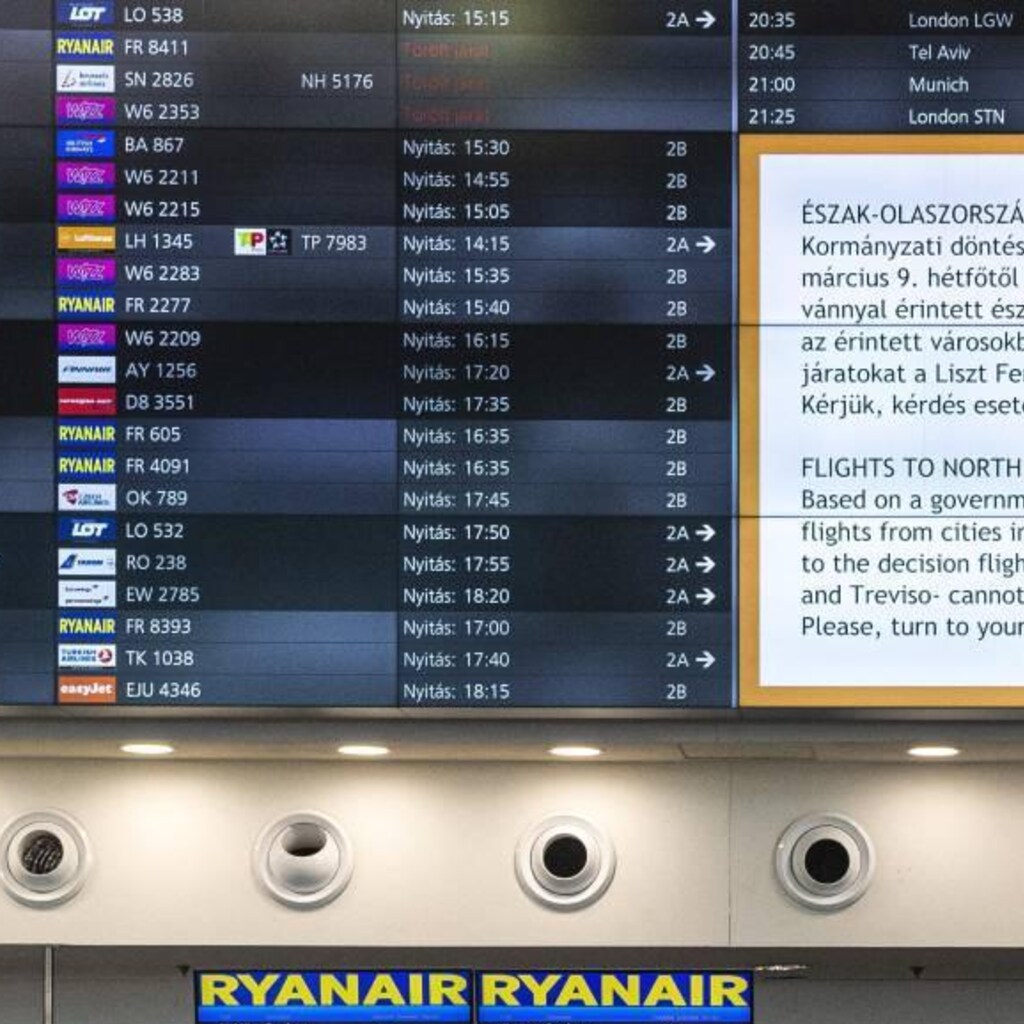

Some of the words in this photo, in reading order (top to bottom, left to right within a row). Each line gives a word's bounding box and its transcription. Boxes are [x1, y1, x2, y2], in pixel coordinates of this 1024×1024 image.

[748, 11, 796, 28] 20:35
[909, 11, 969, 28] London
[974, 11, 1014, 28] LGW
[748, 44, 796, 60] 20:45
[908, 43, 932, 61] Tel
[936, 44, 971, 61] Aviv
[124, 70, 147, 88] SN
[151, 71, 194, 88] 2826
[301, 73, 326, 89] NH
[332, 73, 374, 90] 5176
[748, 107, 796, 125] 21:25
[908, 108, 969, 125] London
[974, 108, 1005, 125] STN
[125, 233, 147, 249] LH
[152, 233, 193, 250] 1345
[300, 234, 322, 250] TP
[325, 234, 367, 251] 7983
[403, 234, 456, 255] Nyitás:
[465, 235, 510, 252] 14:15
[666, 236, 690, 253] 2A
[802, 234, 942, 261] Kormányzati
[57, 296, 116, 313] RYANAIR
[125, 296, 145, 313] FR
[149, 297, 191, 313] 2277
[403, 298, 456, 319] Nyitás:
[465, 299, 510, 316] 15:40
[666, 300, 688, 317] 2B
[801, 336, 827, 352] az
[834, 329, 923, 352] érintett
[125, 394, 150, 411] D8
[154, 394, 193, 411] 3551
[403, 396, 456, 416] Nyitás:
[465, 396, 510, 413] 17:35
[666, 396, 688, 413] 2B
[802, 393, 882, 420] Kérjük,
[892, 393, 966, 415] kérdés
[802, 457, 895, 478] FLIGHTS
[902, 457, 935, 478] TO
[943, 457, 1021, 478] NORTH
[802, 488, 866, 510] Based
[873, 493, 901, 510] on
[909, 494, 922, 510] a
[125, 522, 149, 539] LO
[153, 522, 184, 539] 532
[403, 524, 456, 544] Nyitás:
[464, 524, 510, 540] 17:50
[666, 525, 690, 541] 2A
[801, 584, 842, 605] and
[849, 584, 940, 605] Treviso-
[59, 682, 114, 695] easyJet
[126, 681, 154, 698] EJU
[158, 681, 202, 698] 4346
[403, 682, 456, 703] Nyitás:
[465, 683, 510, 700] 18:15
[666, 683, 688, 700] 2B
[201, 973, 467, 1006] RYANAIR
[482, 974, 748, 1006] RYANAIR
